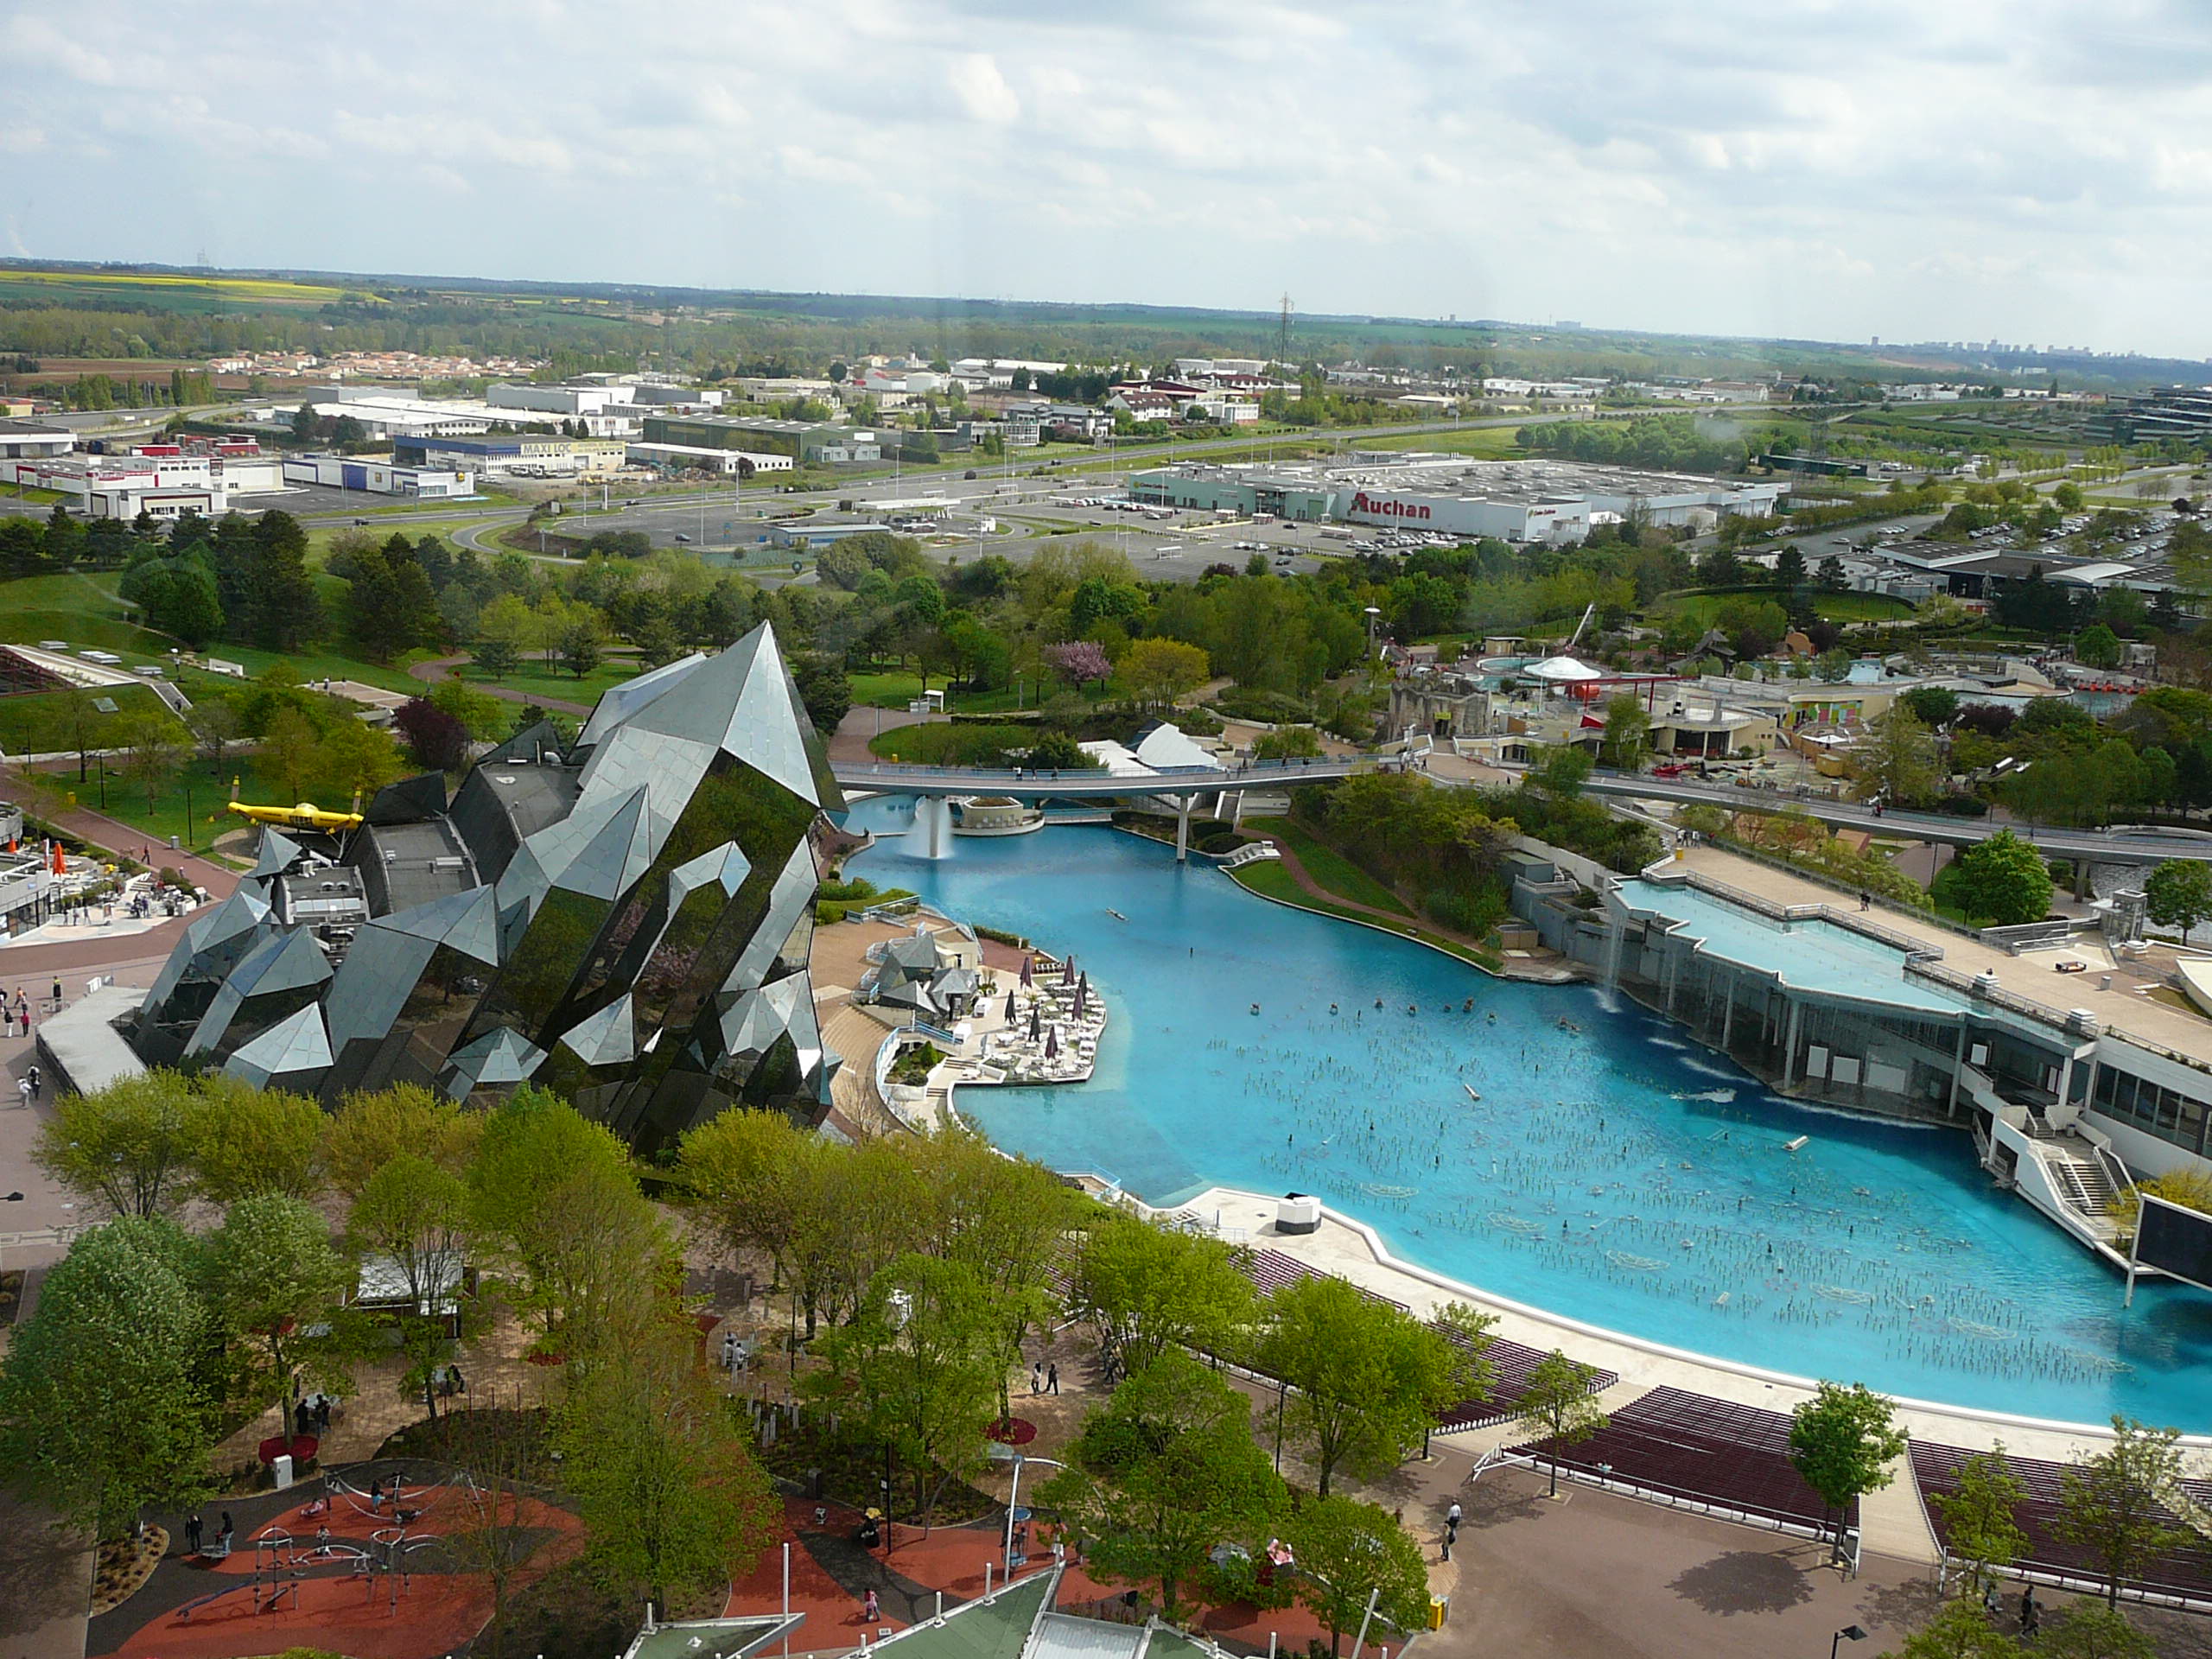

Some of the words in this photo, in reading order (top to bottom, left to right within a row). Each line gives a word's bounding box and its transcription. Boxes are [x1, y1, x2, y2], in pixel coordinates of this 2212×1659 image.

[524, 443, 550, 454] MAXI
[554, 442, 571, 454] LOC
[1351, 493, 1430, 518] Auchan
